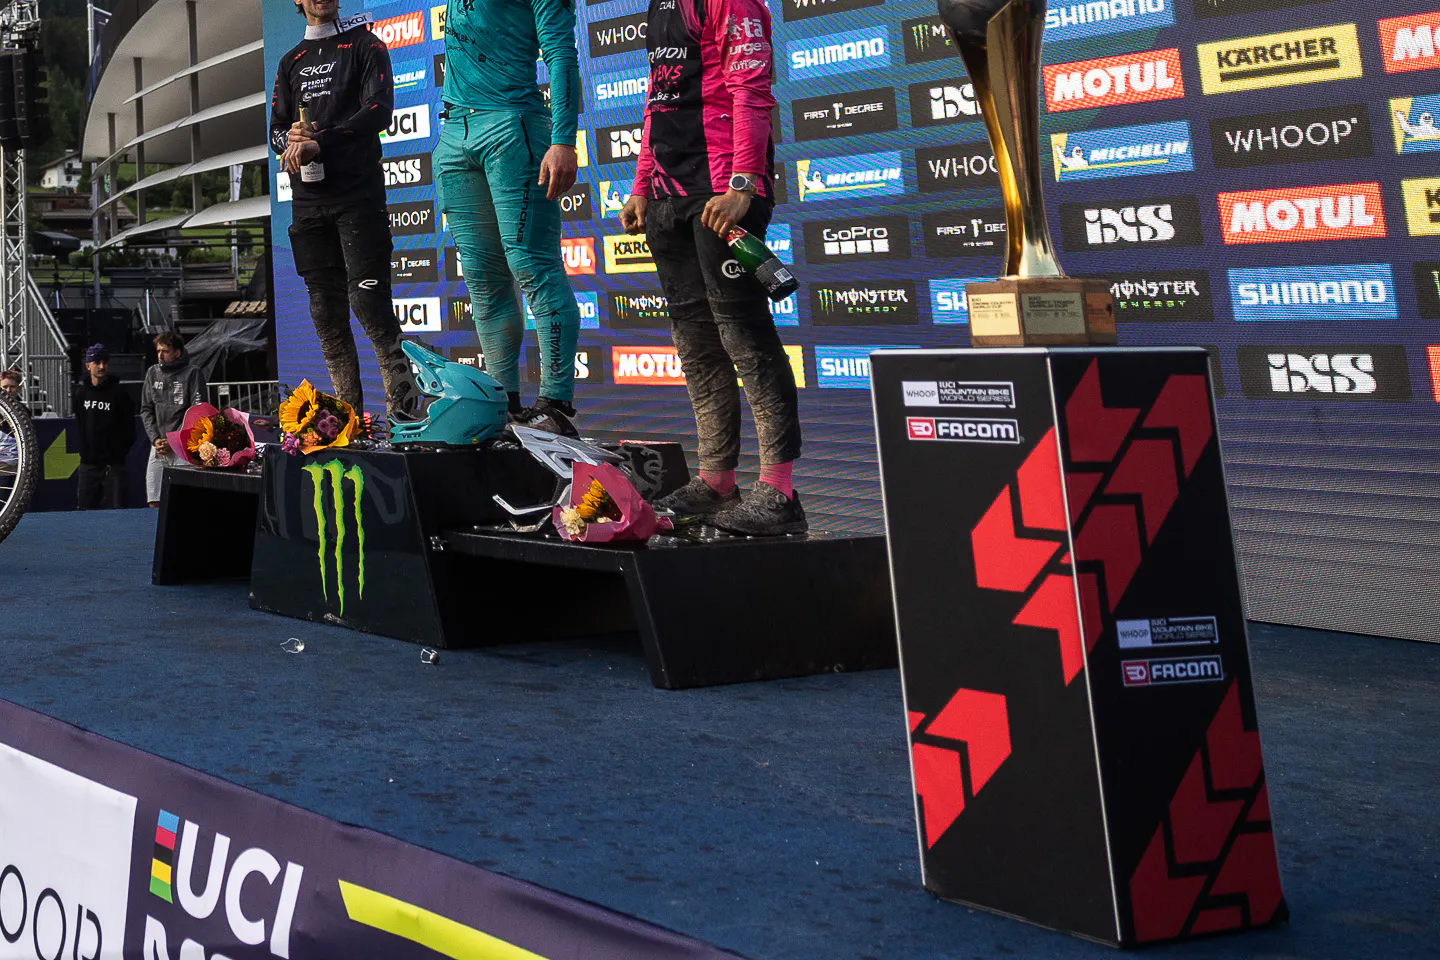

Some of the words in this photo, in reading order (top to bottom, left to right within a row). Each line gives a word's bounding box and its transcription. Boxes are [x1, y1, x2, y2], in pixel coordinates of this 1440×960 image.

[597, 22, 648, 46] WHOO
[791, 37, 885, 69] SHIMANO
[1217, 36, 1338, 69] KÄRCHER
[597, 77, 649, 101] SHIMA
[1052, 59, 1175, 103] MOTUL
[804, 109, 830, 121] FIRST
[1224, 119, 1355, 154] WHOOP
[1090, 141, 1189, 163] MICHELIN
[826, 167, 901, 185] MICHELIN
[389, 209, 428, 228] HOOP
[1230, 194, 1375, 234] MOTUL
[823, 226, 888, 242] GoPro
[937, 225, 967, 236] FIRST
[613, 240, 651, 256] KÄRC
[835, 288, 908, 304] MONSTER
[1238, 280, 1386, 306] SHIMANO
[619, 353, 685, 378] MOTU
[820, 357, 871, 377] SHIM
[906, 390, 936, 398] WHOOP
[942, 381, 956, 389] UCI
[91, 400, 111, 411] FOX
[938, 422, 1015, 439] FACOM
[1120, 628, 1149, 639] WHOOP
[1152, 624, 1194, 633] MOUNTAIN
[1152, 660, 1219, 679] FACOM
[176, 819, 305, 960] UCI
